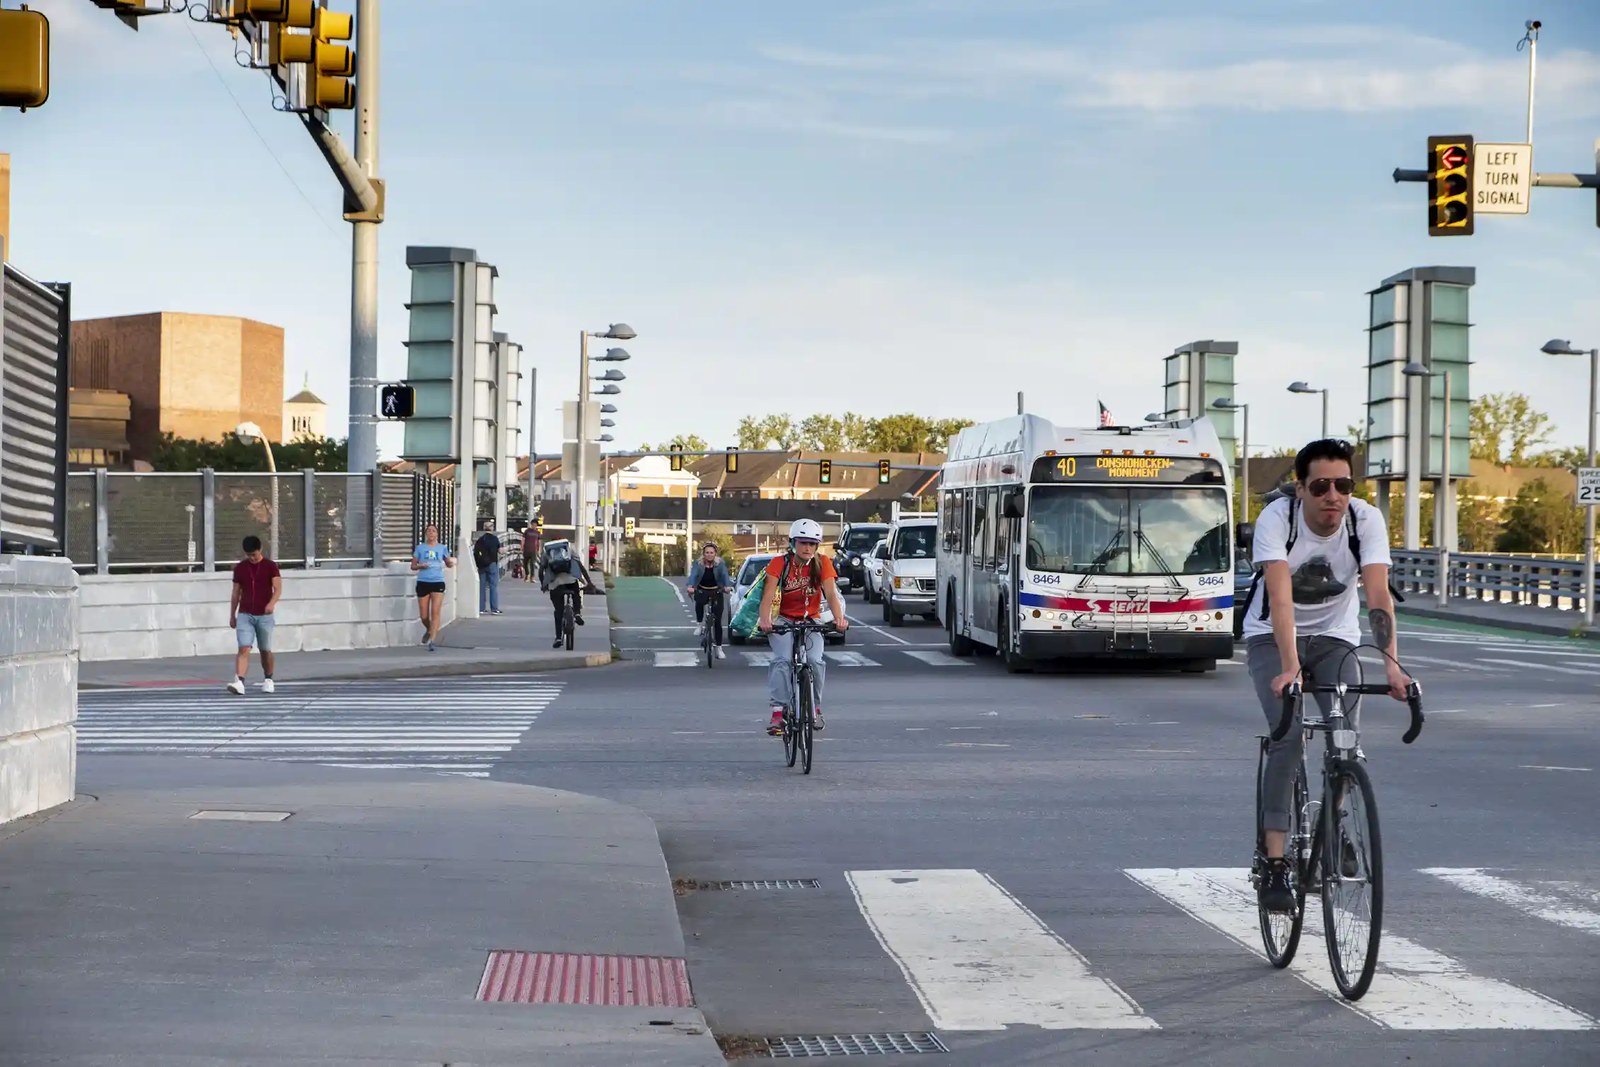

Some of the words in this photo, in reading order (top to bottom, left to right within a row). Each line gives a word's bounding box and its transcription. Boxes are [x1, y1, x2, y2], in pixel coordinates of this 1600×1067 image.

[1487, 152, 1518, 165] LEFT
[1485, 172, 1519, 185] TURN
[1477, 190, 1523, 205] SIGNAL
[1056, 457, 1076, 477] 40
[1109, 468, 1160, 478] MONUMENT
[1580, 486, 1600, 500] 25
[1033, 574, 1061, 585] 8464
[1198, 576, 1224, 586] 8464
[1109, 602, 1149, 612] SEPTA
